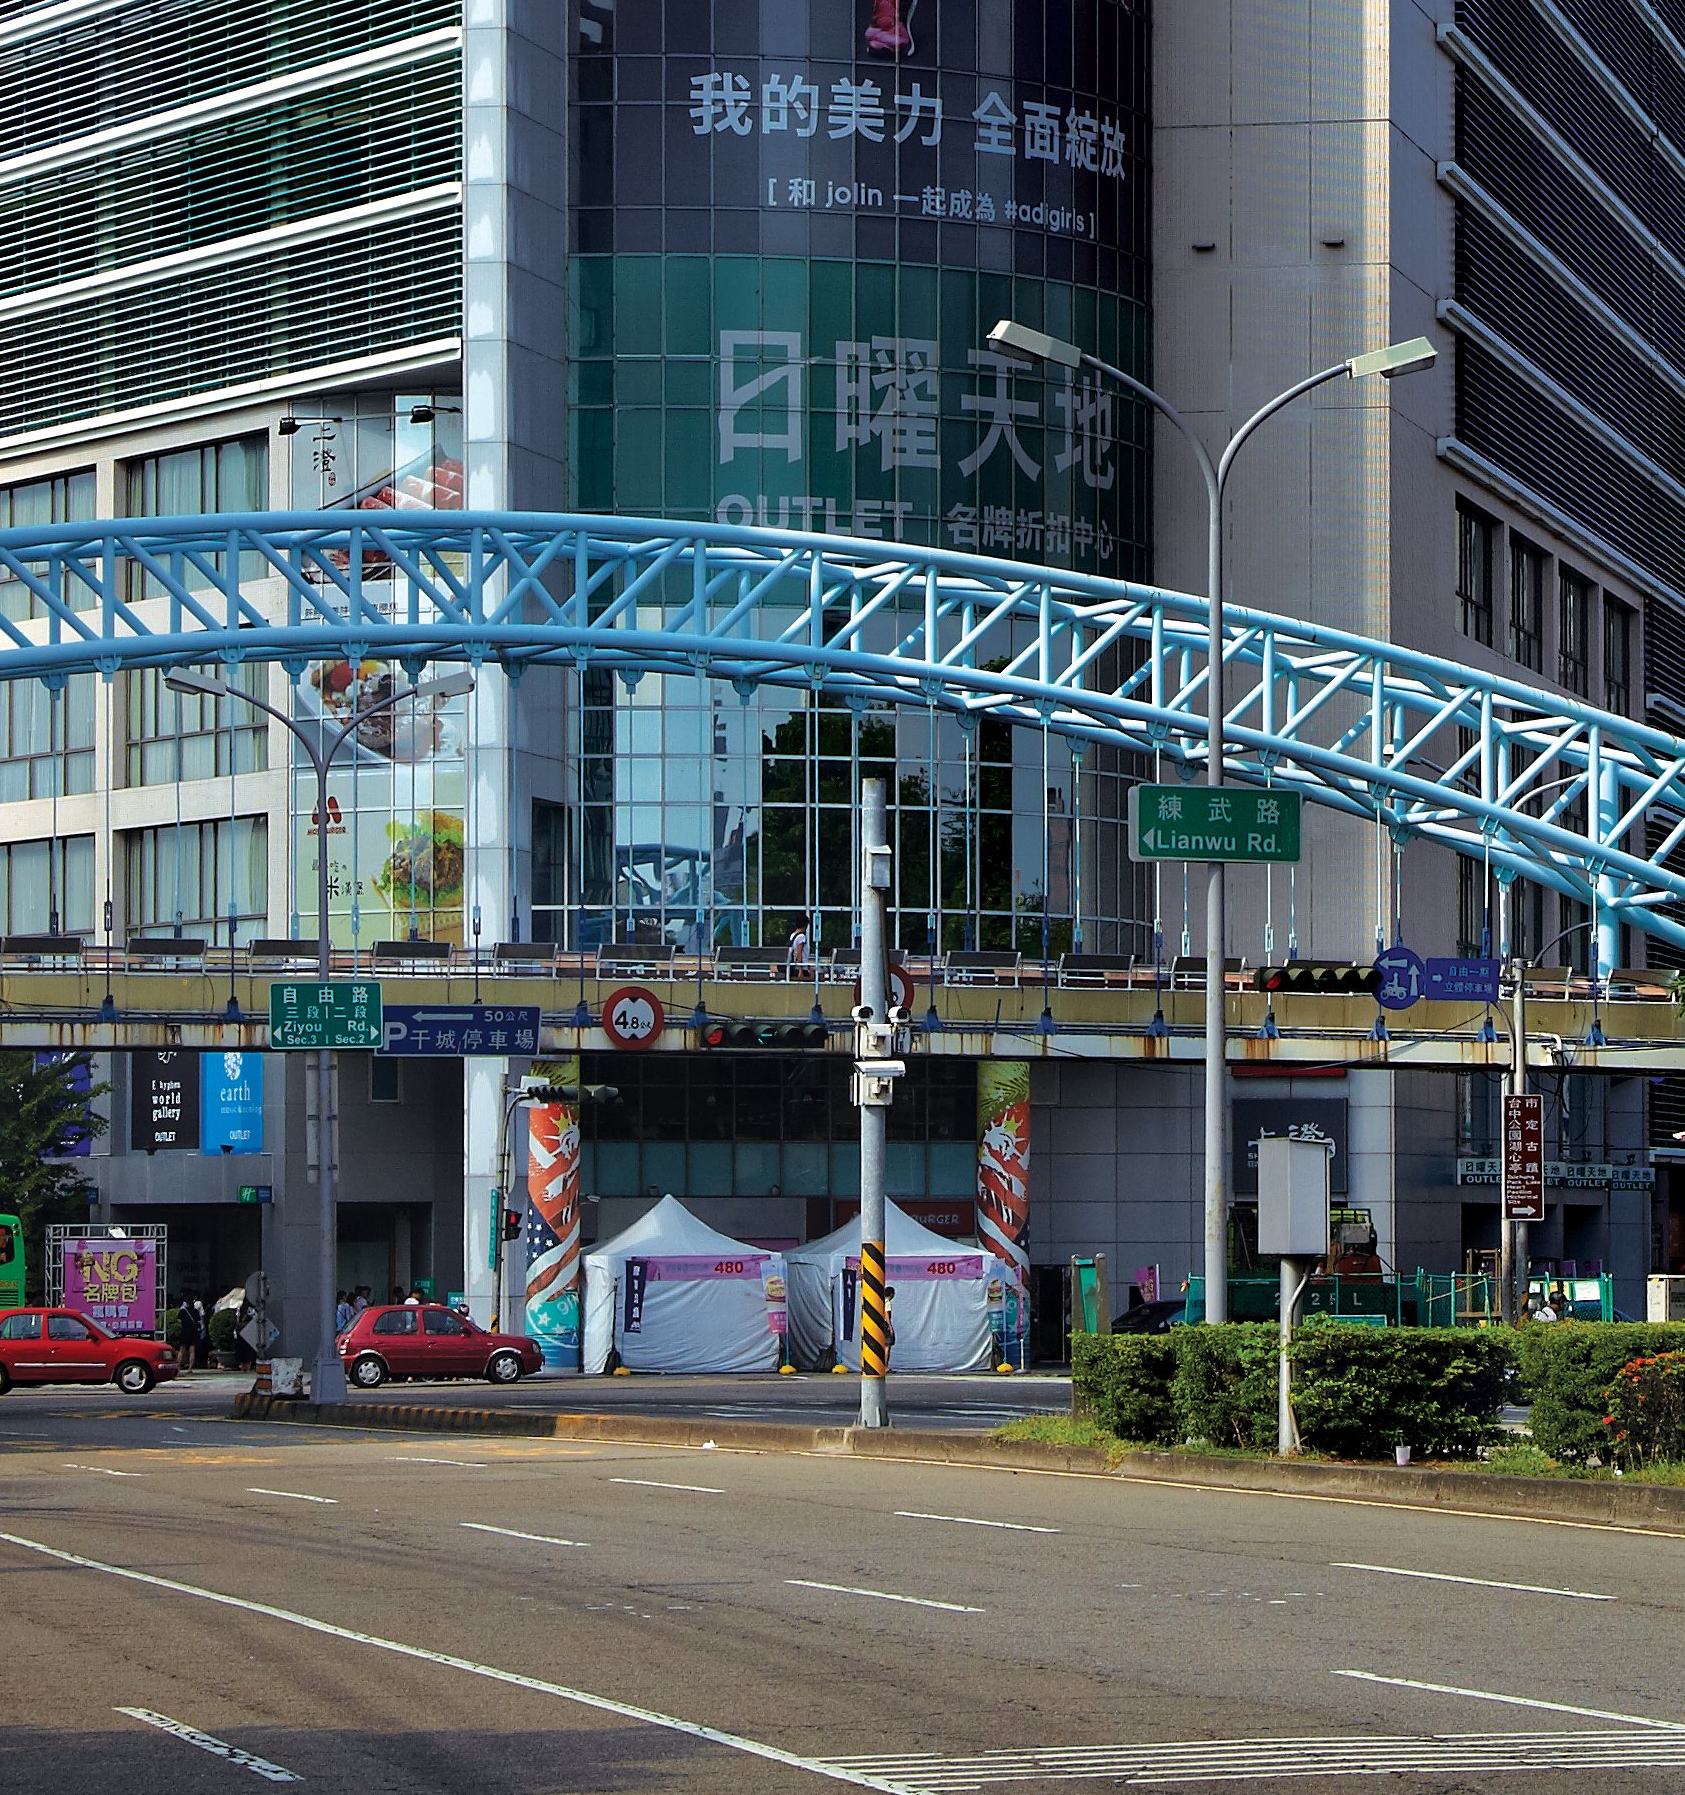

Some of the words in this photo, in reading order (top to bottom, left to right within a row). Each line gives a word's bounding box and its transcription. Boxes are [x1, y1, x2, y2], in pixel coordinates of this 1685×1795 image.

[689, 71, 943, 147] 我的美力
[971, 91, 1127, 181] 全面綻放
[825, 181, 883, 208] jolin
[892, 185, 997, 224] 一起成為
[1003, 199, 1084, 233] #adigirls
[717, 329, 1115, 491] 日曜天地
[717, 494, 913, 541] OUTLET
[946, 501, 1115, 560] 名牌折扣中心
[1157, 794, 1281, 835] 練武路
[1156, 829, 1236, 851] Lianwu
[1247, 833, 1282, 854] Rd.
[283, 986, 369, 1004] 自由路
[285, 1006, 320, 1019] 三段
[333, 1006, 367, 1019] 二段
[283, 1022, 322, 1035] Ziyou
[347, 1020, 369, 1032] Rd.
[286, 1035, 317, 1044] Sec.3
[335, 1035, 366, 1044] Sec.2
[410, 1028, 535, 1051] 干城停車場
[151, 1091, 182, 1105] world
[220, 1080, 251, 1102] earth
[152, 1106, 182, 1122] gallery
[1567, 1179, 1607, 1187] OUTLET
[81, 1248, 139, 1283] NG
[714, 1262, 744, 1274] 480
[927, 1262, 956, 1275] 480
[83, 1284, 138, 1303] 名牌包
